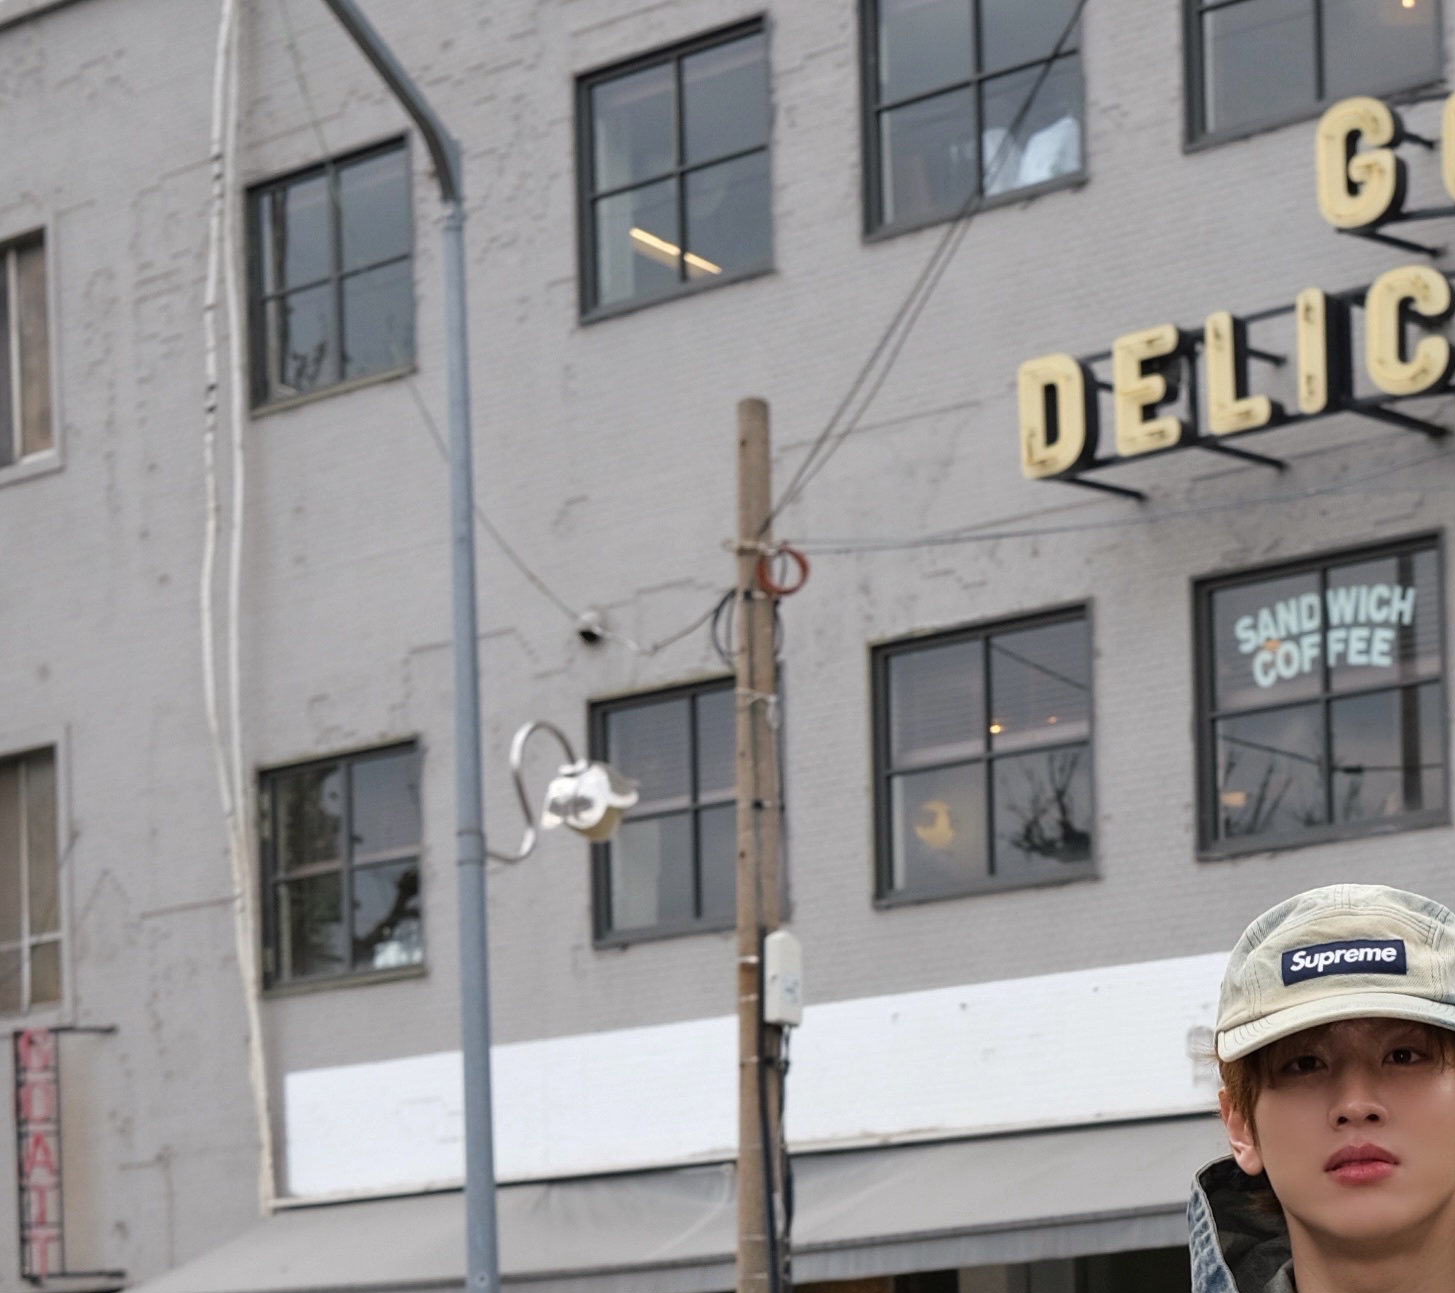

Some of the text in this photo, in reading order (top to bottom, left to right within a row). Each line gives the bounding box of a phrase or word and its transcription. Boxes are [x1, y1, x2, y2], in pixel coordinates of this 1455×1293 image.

[1235, 584, 1416, 653] SANDWICH
[1253, 627, 1396, 688] COFFEE
[1290, 947, 1397, 972] Supreme
